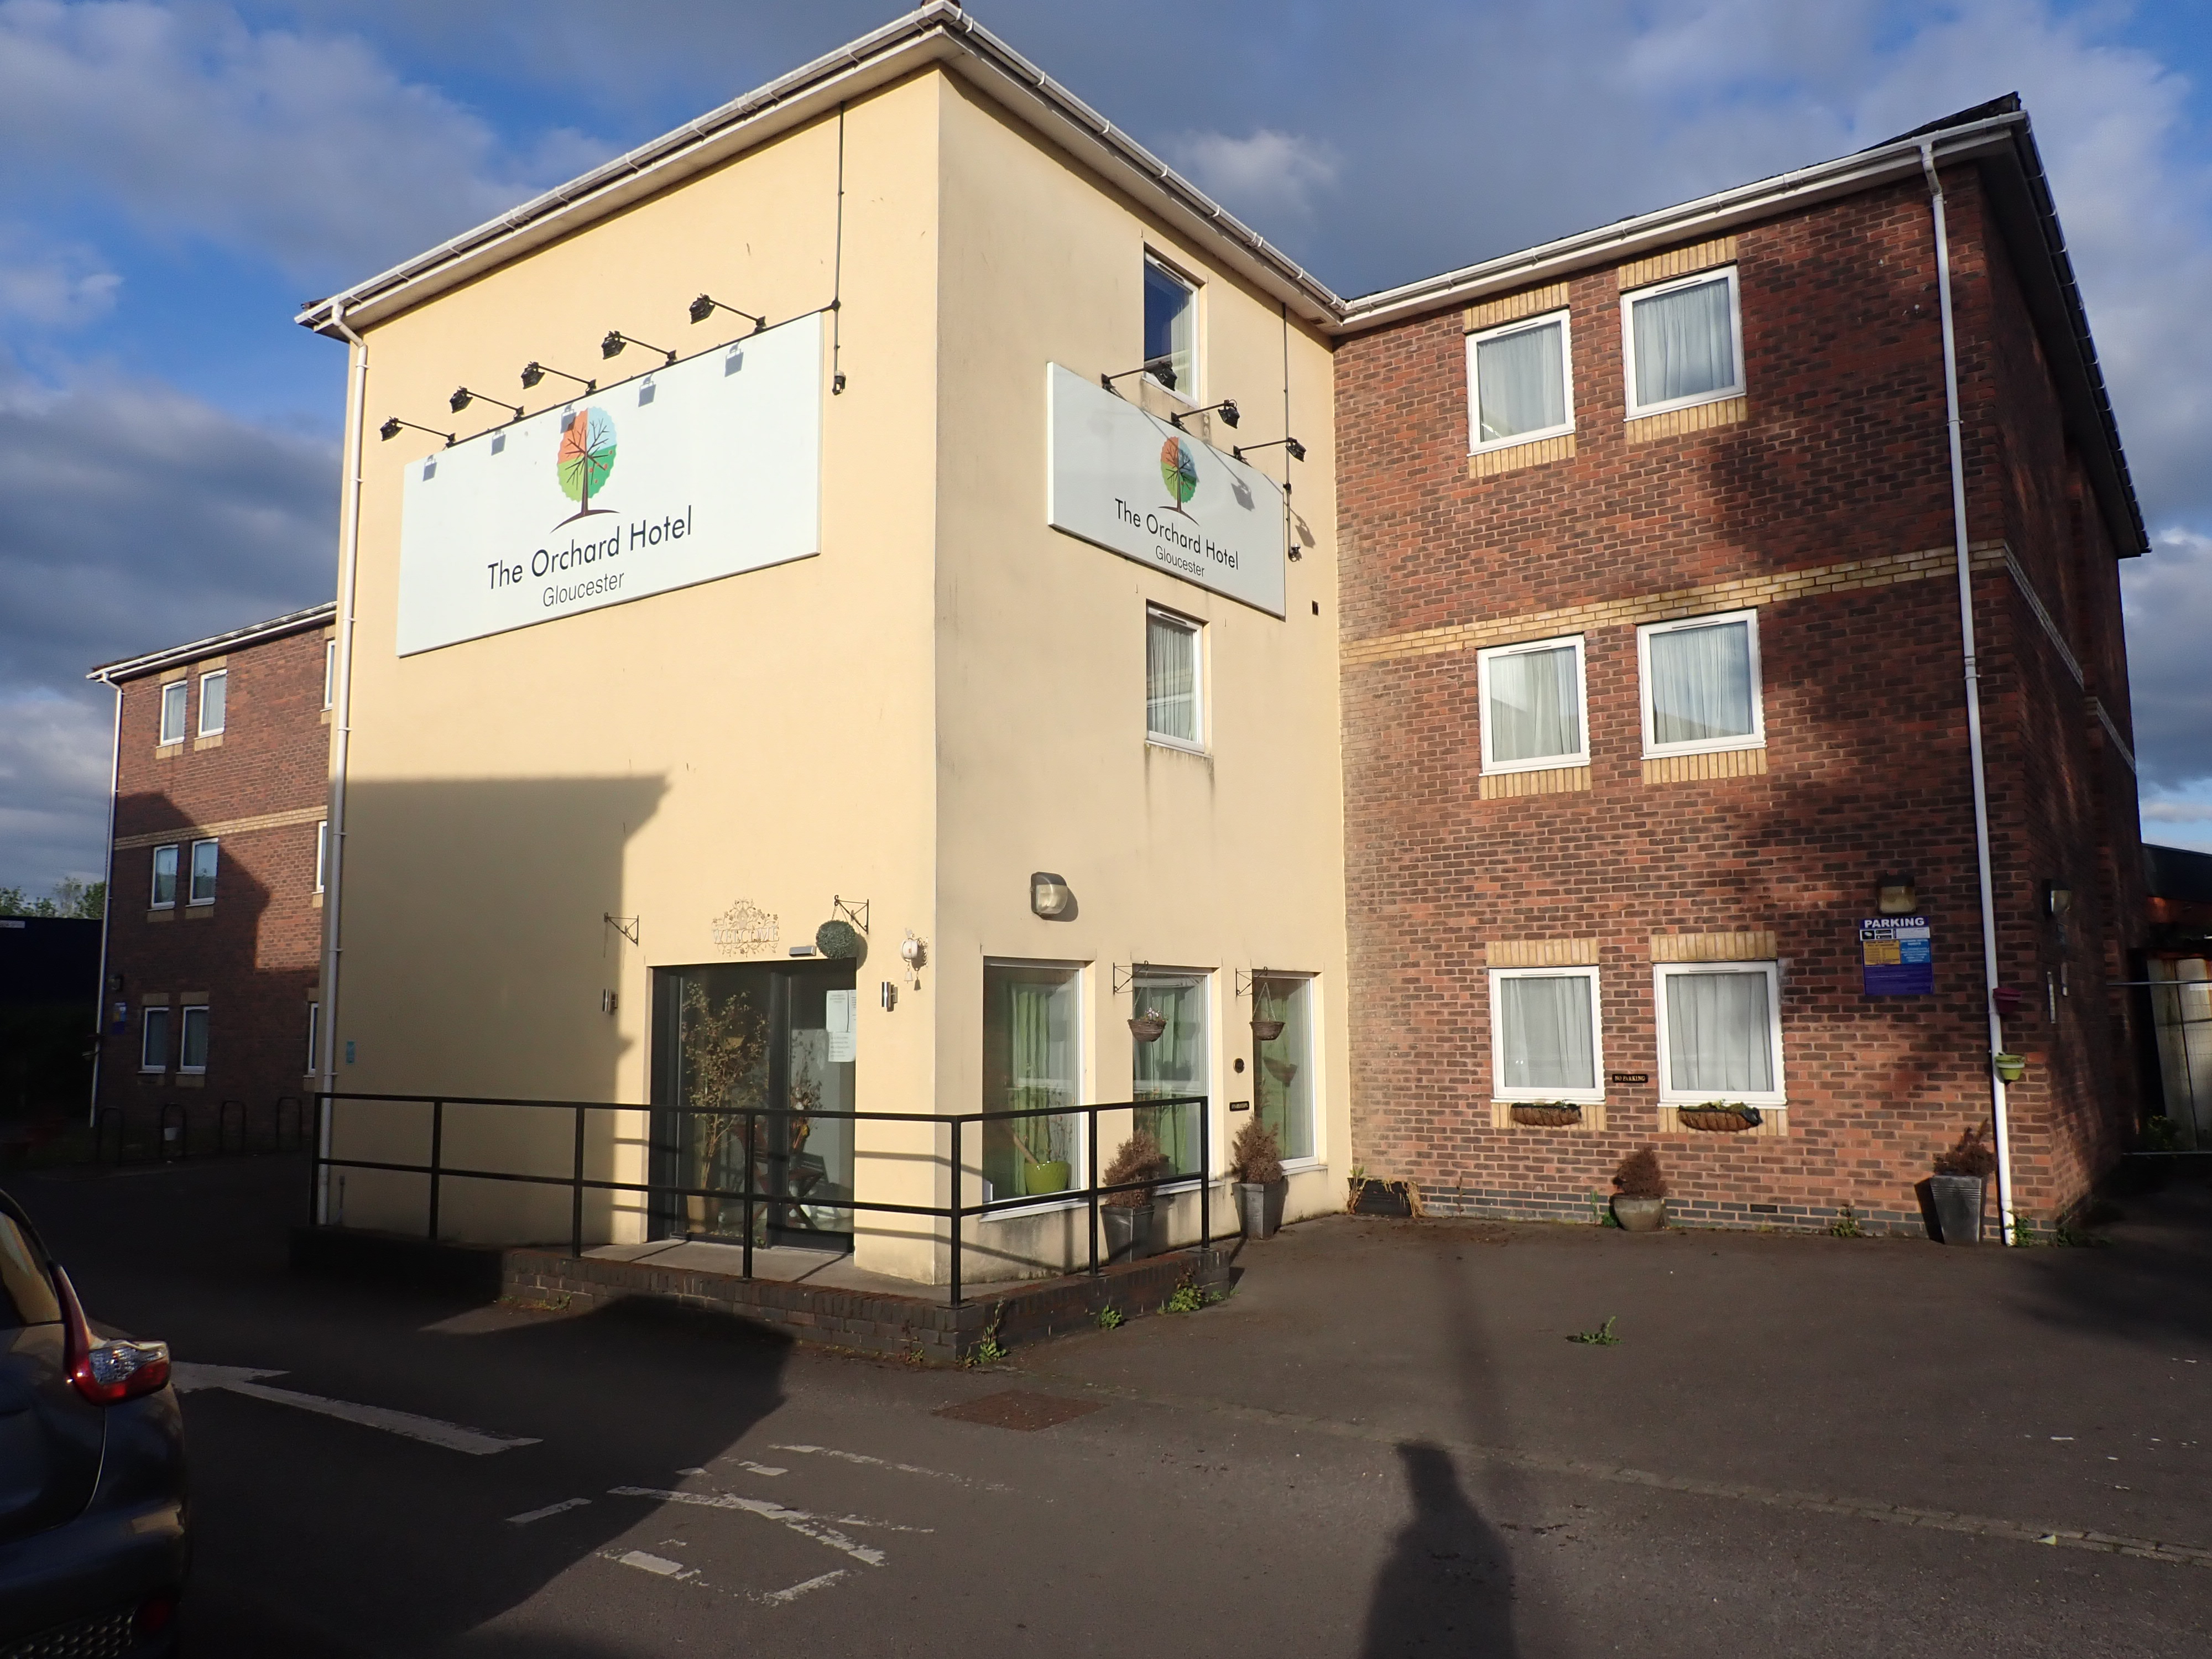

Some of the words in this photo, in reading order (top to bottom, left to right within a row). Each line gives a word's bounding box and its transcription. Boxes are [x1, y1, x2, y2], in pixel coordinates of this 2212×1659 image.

[487, 560, 523, 590] The
[531, 525, 620, 578] Orchard
[629, 504, 692, 552] Hotel
[1114, 497, 1141, 528] The
[1146, 513, 1201, 555] Orchard
[1206, 538, 1239, 571] Hotel
[1155, 545, 1206, 578] Gloucester
[542, 572, 625, 608] Gloucester
[712, 926, 780, 944] WELCOME
[1864, 917, 1924, 928] PARKING
